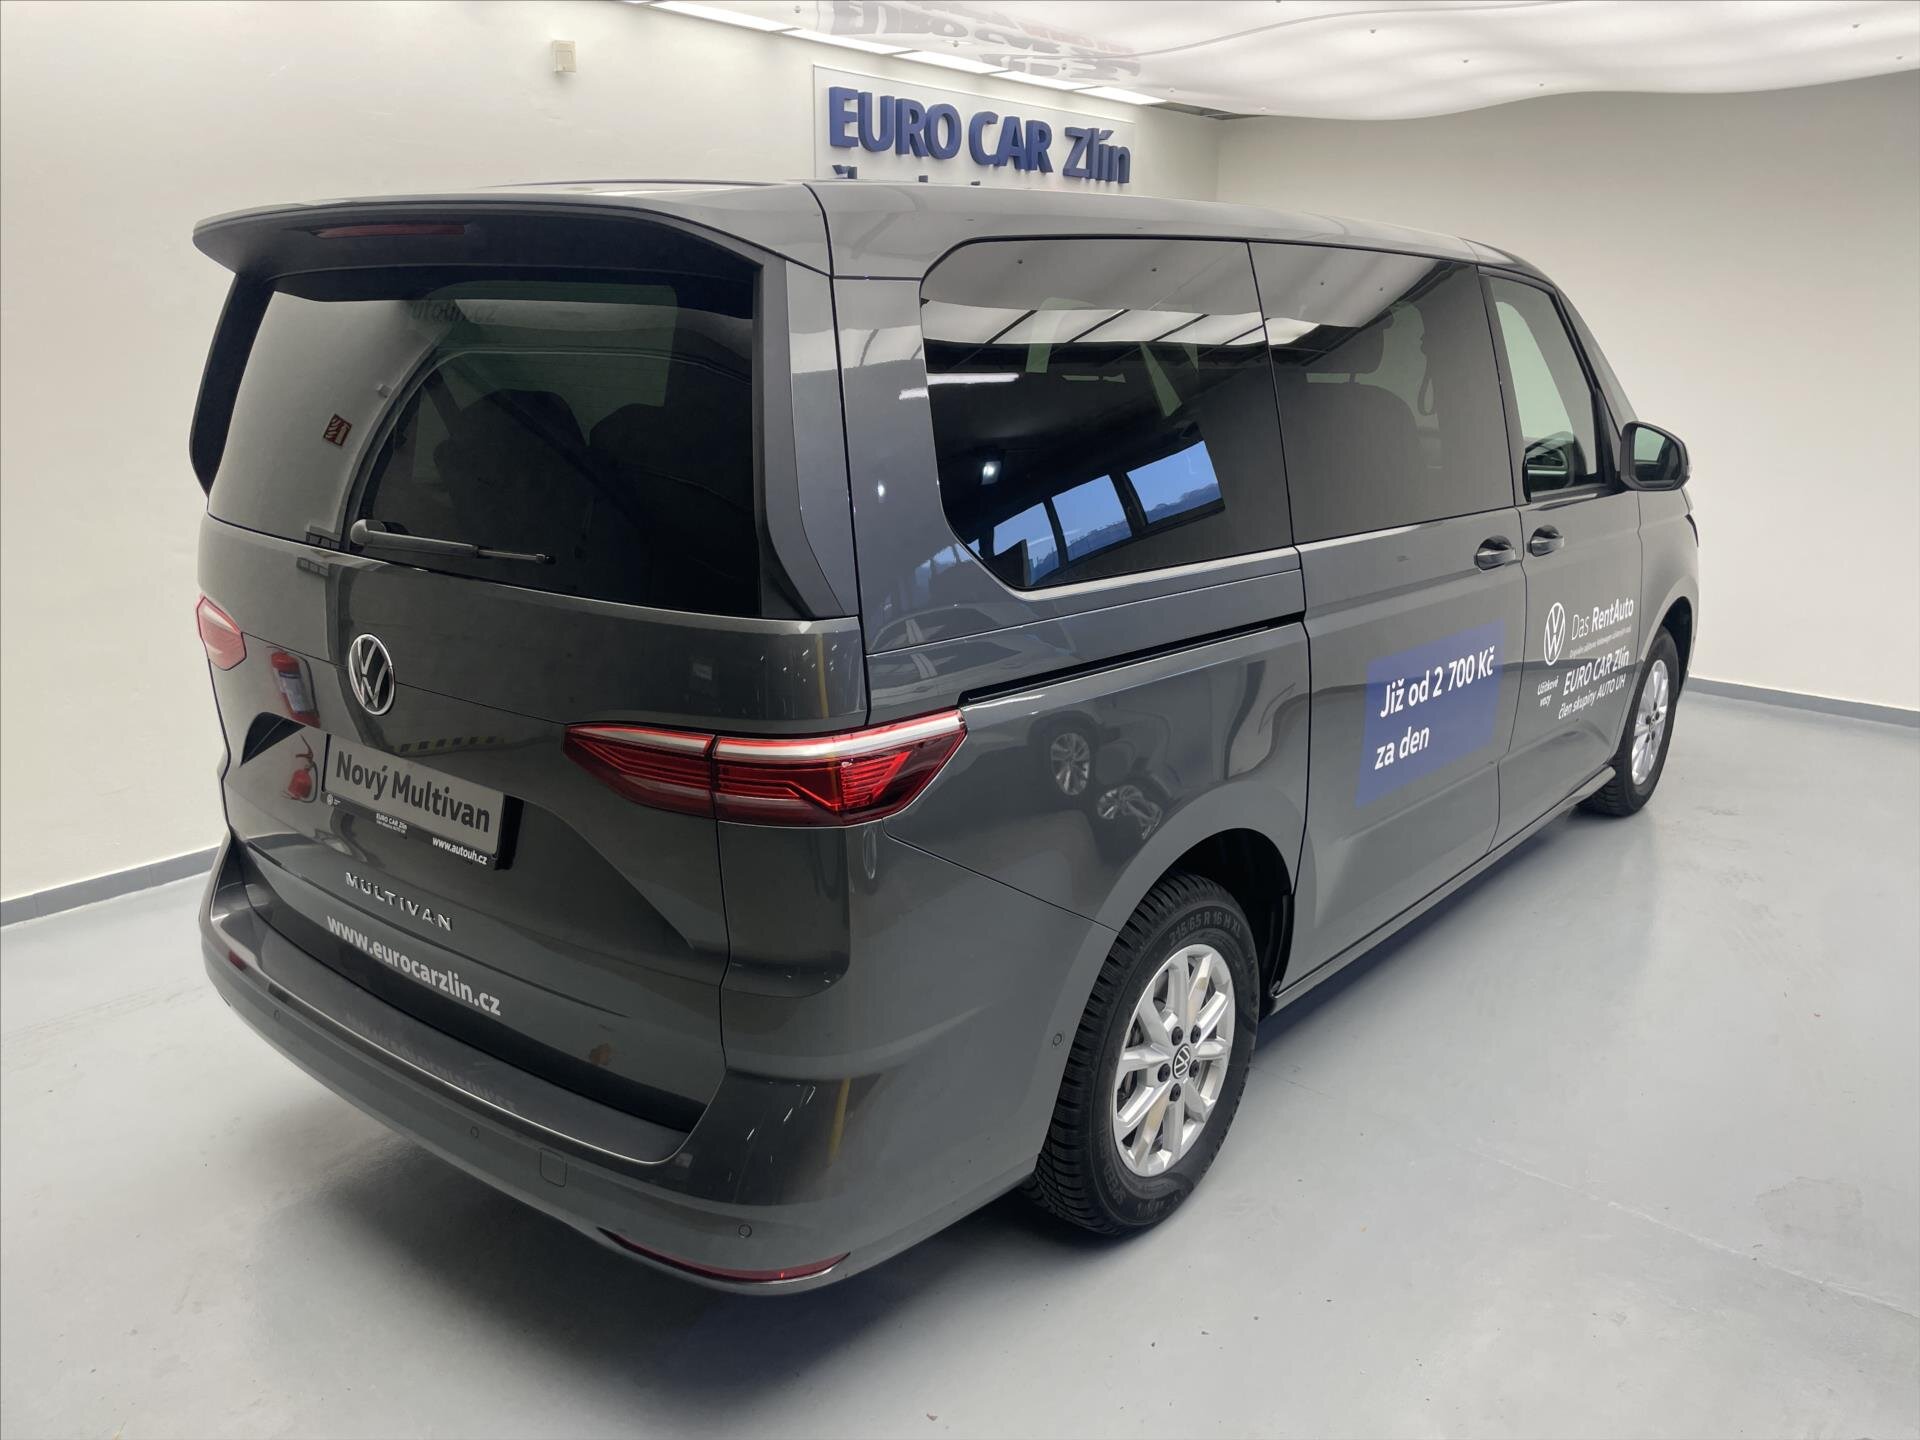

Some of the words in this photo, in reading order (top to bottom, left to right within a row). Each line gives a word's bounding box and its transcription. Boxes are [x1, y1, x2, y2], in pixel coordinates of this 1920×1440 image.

[829, 86, 962, 160] EURO
[968, 111, 1053, 173] CAR
[1063, 127, 1131, 184] Zlín
[1571, 614, 1589, 640] Das
[1591, 598, 1634, 632] RentAuto
[1380, 678, 1405, 718] Již
[1408, 670, 1430, 706] od
[1432, 666, 1443, 698] 2
[1448, 655, 1475, 691] 700
[1477, 645, 1495, 679] Kč
[1563, 662, 1593, 696] EURO
[1593, 653, 1613, 680] CAR
[1612, 645, 1630, 672] Zlín
[1596, 678, 1616, 700] AUTO
[1374, 742, 1395, 770] za
[1399, 726, 1430, 759] den
[336, 751, 388, 800] Nový
[392, 770, 490, 833] Multivan
[432, 836, 488, 866] www.autouh.cz
[345, 872, 453, 931] MULTIVAN
[327, 915, 501, 1016] www.eurocarzlin.cz
